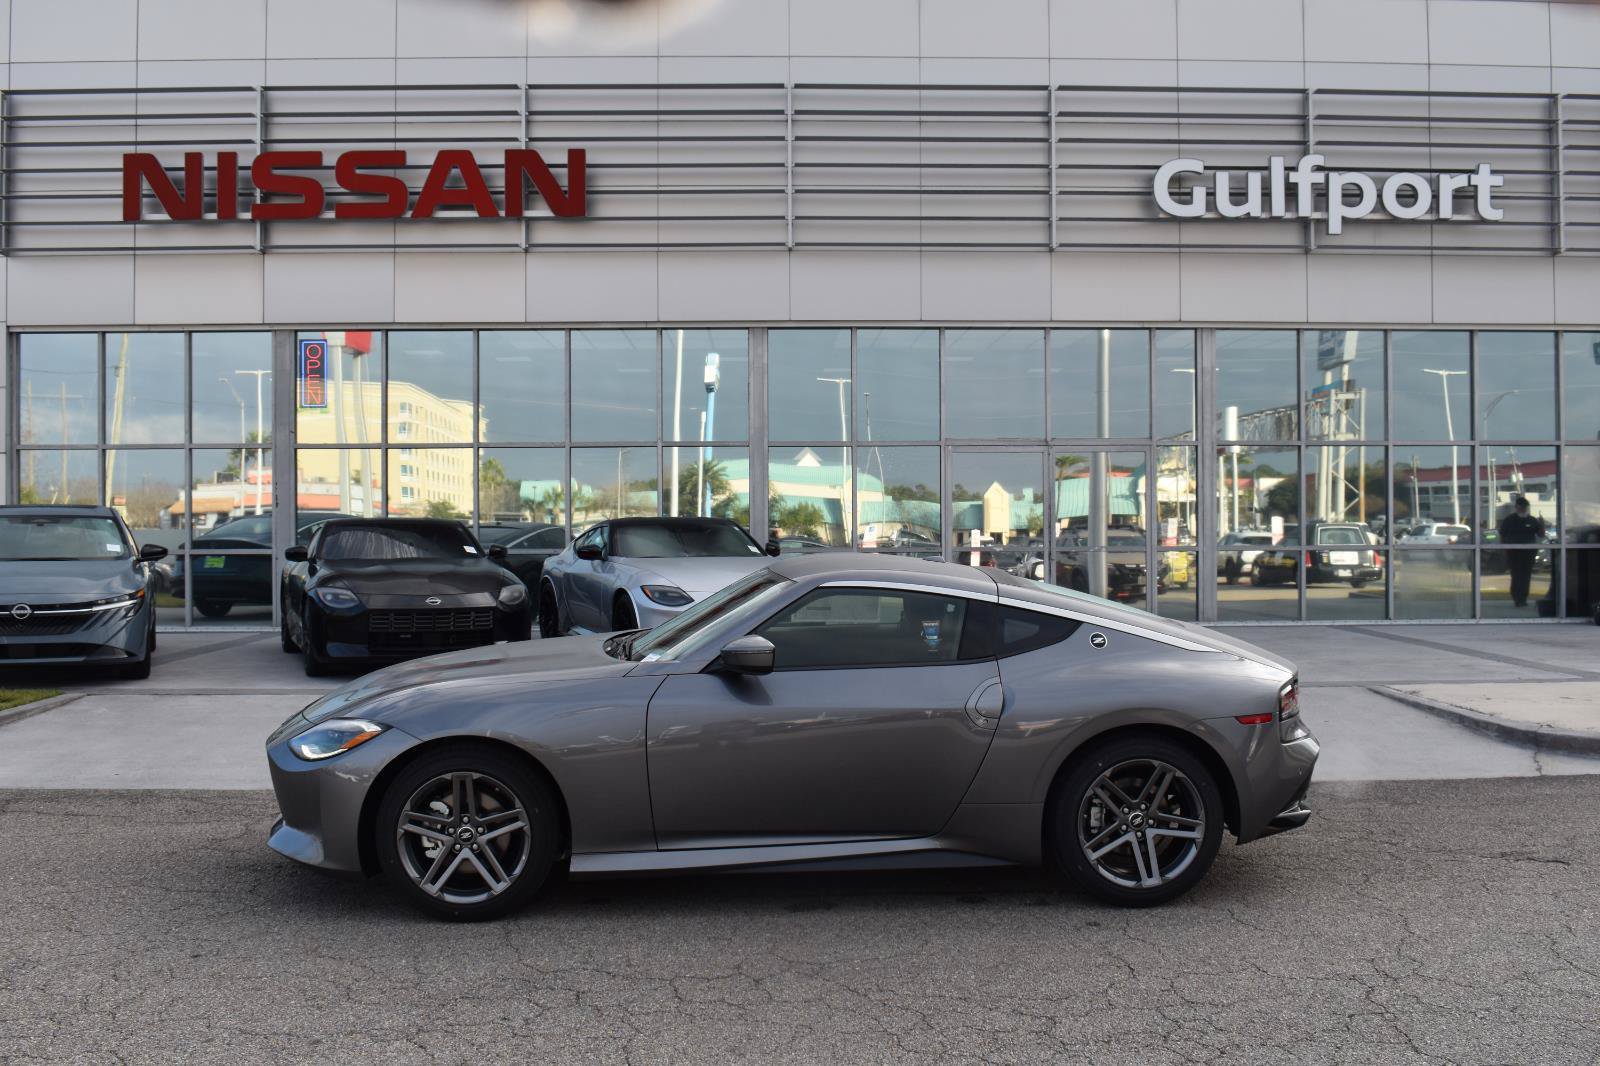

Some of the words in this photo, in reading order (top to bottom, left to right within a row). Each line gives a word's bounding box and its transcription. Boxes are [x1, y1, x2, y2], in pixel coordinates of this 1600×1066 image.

[123, 148, 587, 221] NISSAN
[1153, 154, 1504, 235] Gulfport
[306, 344, 322, 404] OPEN
